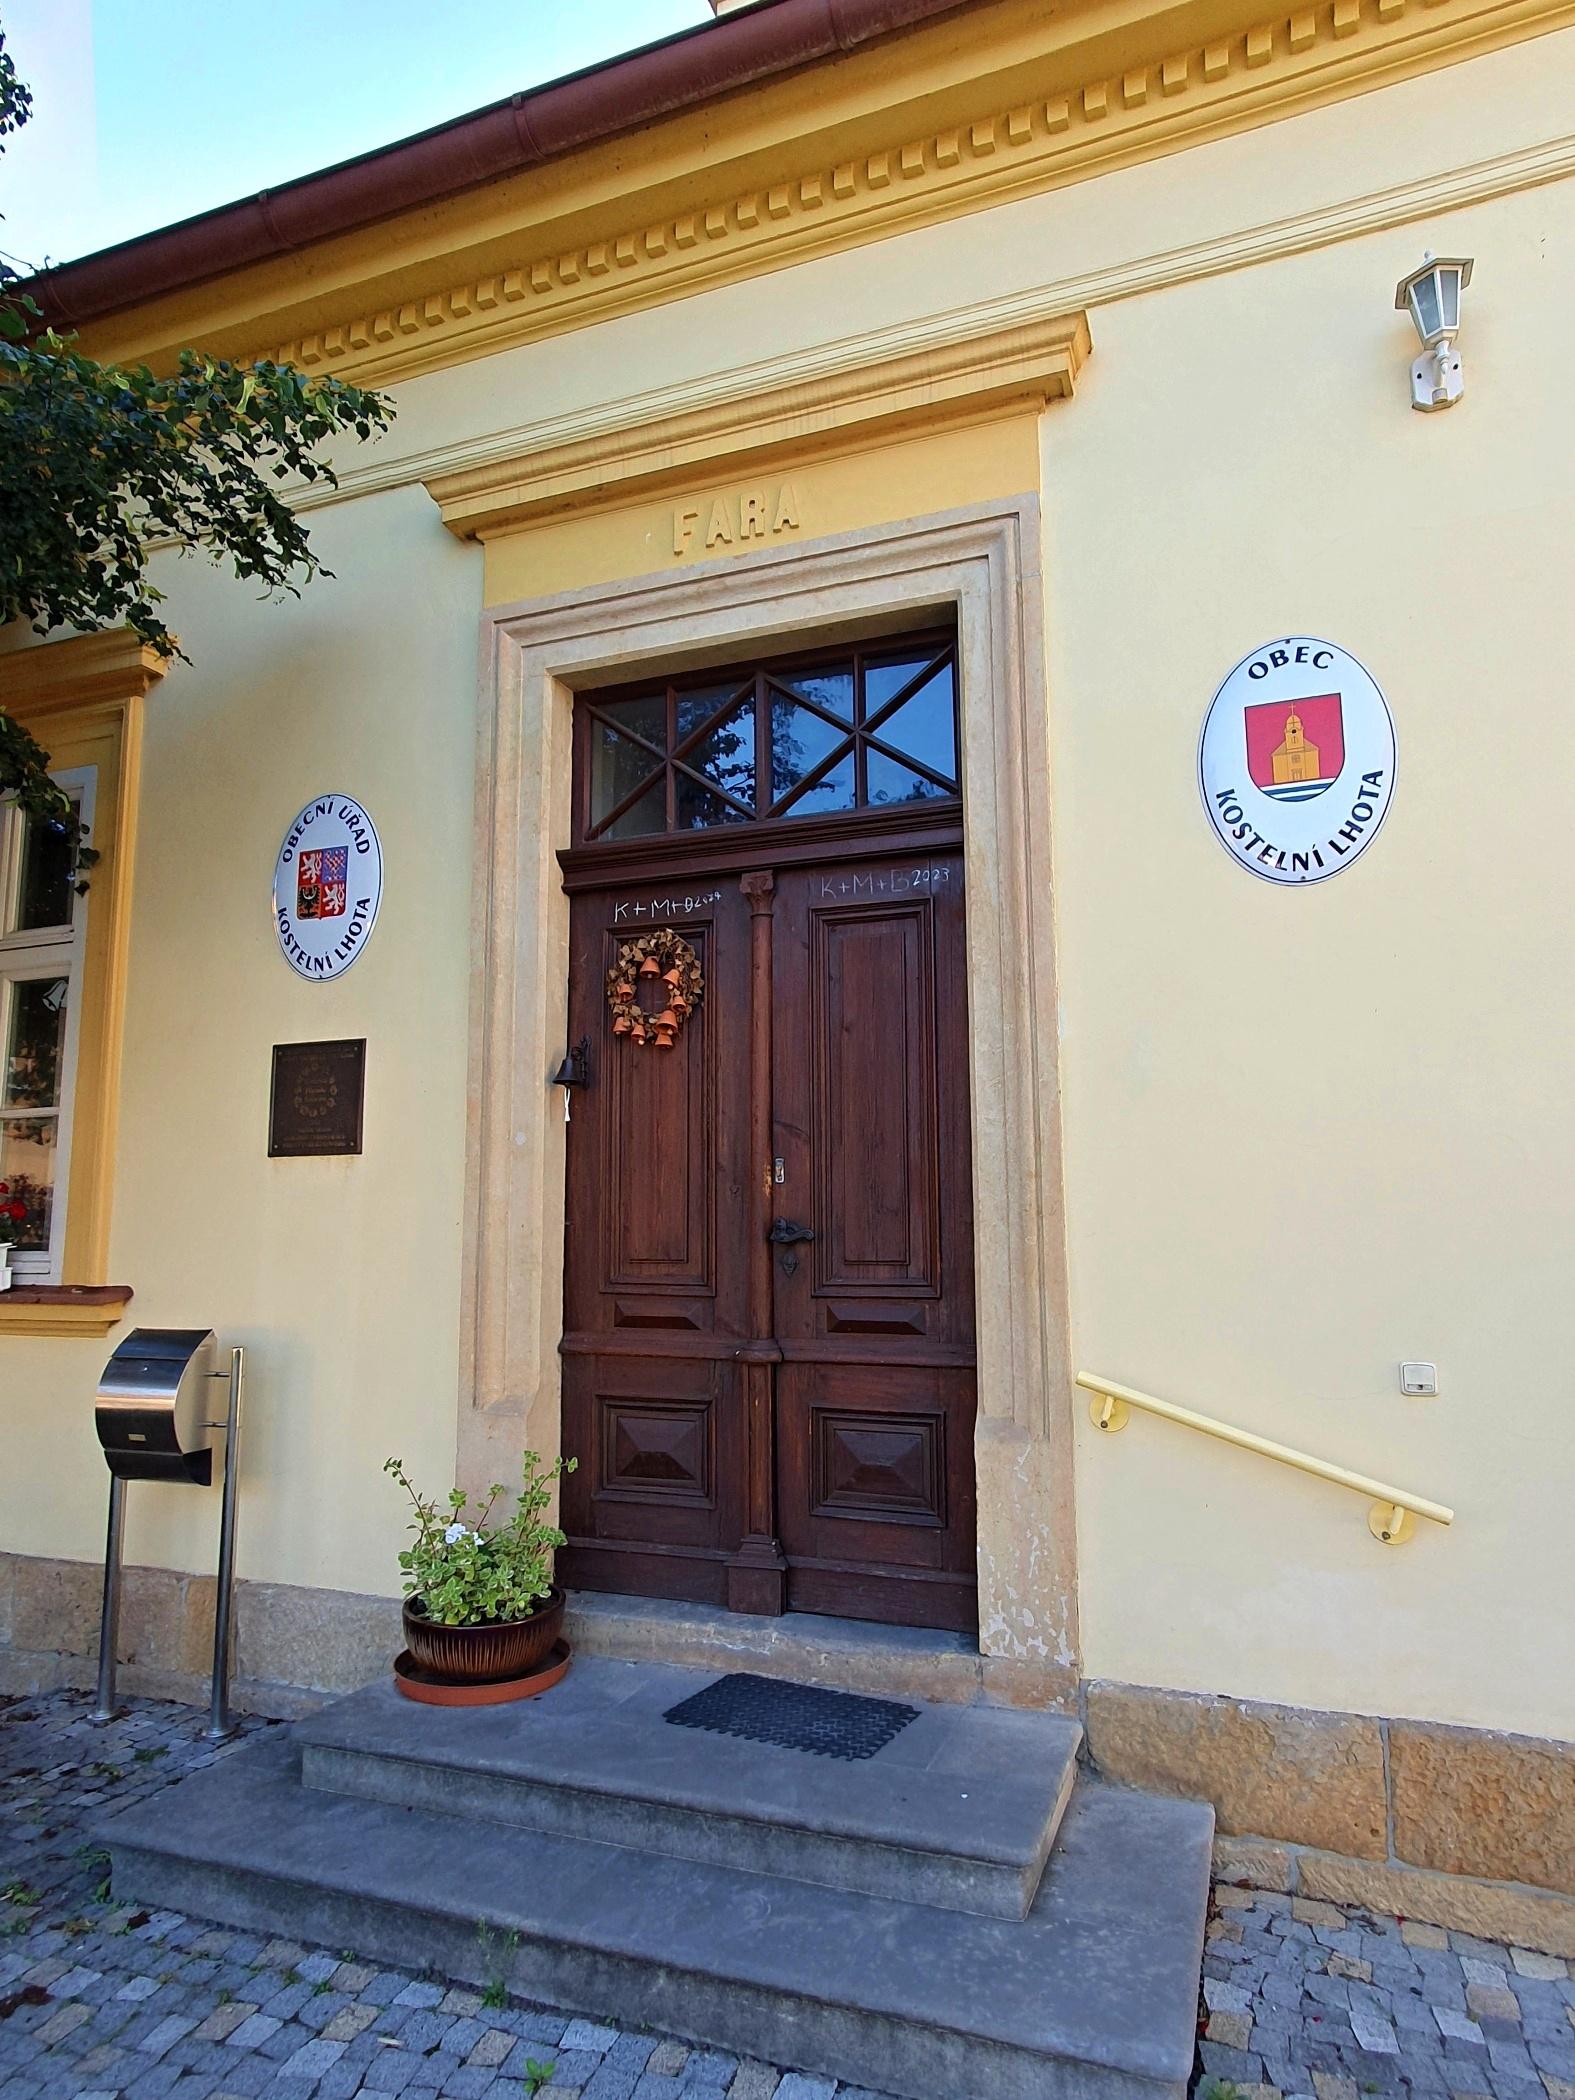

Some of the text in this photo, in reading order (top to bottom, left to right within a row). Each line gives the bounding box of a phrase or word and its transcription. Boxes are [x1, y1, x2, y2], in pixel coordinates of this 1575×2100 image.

[673, 483, 800, 556] FARA
[1247, 646, 1334, 680] OBEC
[282, 798, 370, 863] OBECNÍ ÚŘAD
[1216, 770, 1384, 872] KOSTELNÍ LHOTA
[277, 897, 371, 972] KOSTELNÍ LHOTA
